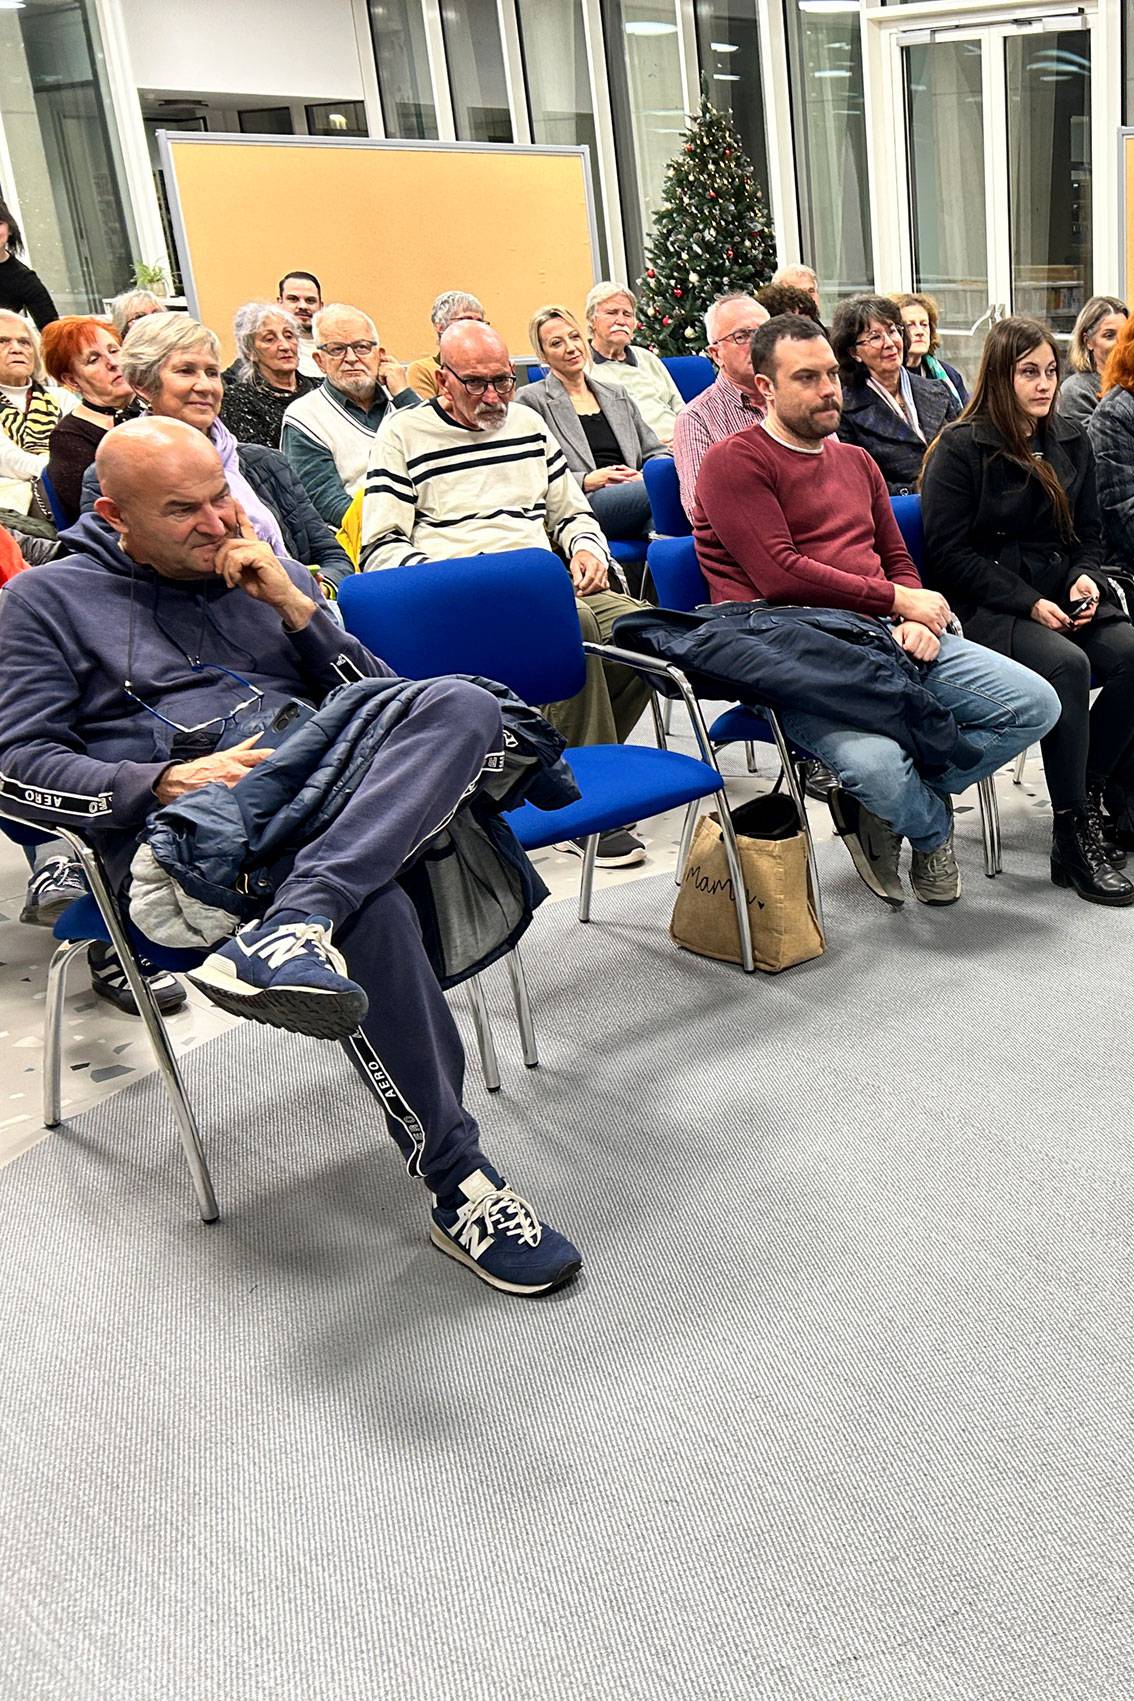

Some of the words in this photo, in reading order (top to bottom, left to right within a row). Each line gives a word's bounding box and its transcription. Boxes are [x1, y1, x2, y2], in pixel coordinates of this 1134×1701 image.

[25, 790, 62, 807] AERO
[368, 1061, 396, 1098] AERO
[458, 1223, 495, 1260] N
